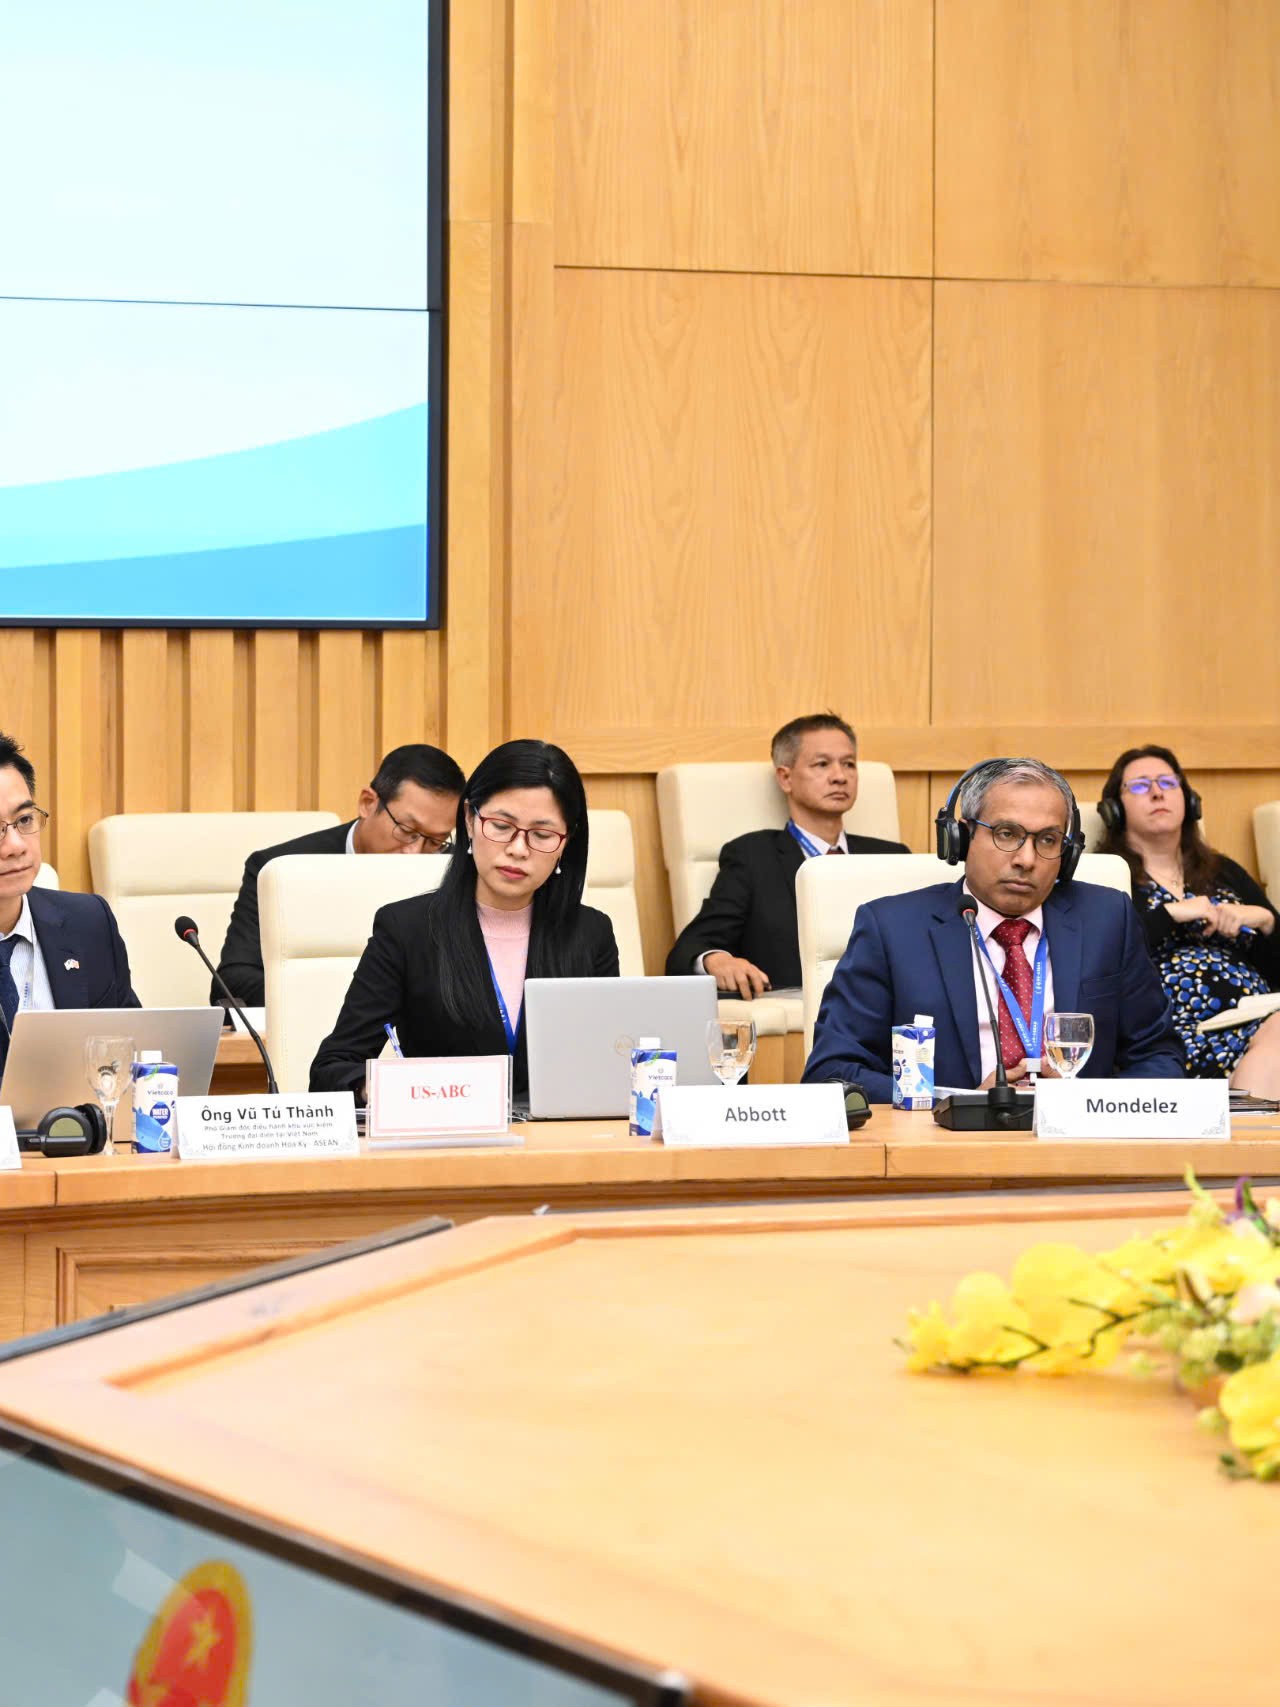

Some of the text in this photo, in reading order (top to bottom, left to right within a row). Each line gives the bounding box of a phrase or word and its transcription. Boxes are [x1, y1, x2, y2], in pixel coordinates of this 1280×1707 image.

[410, 1084, 471, 1100] US-ABC
[1086, 1097, 1178, 1113] Mondelez
[200, 1104, 334, 1124] Ông Vũ Tú Thành
[725, 1106, 787, 1122] Abbott
